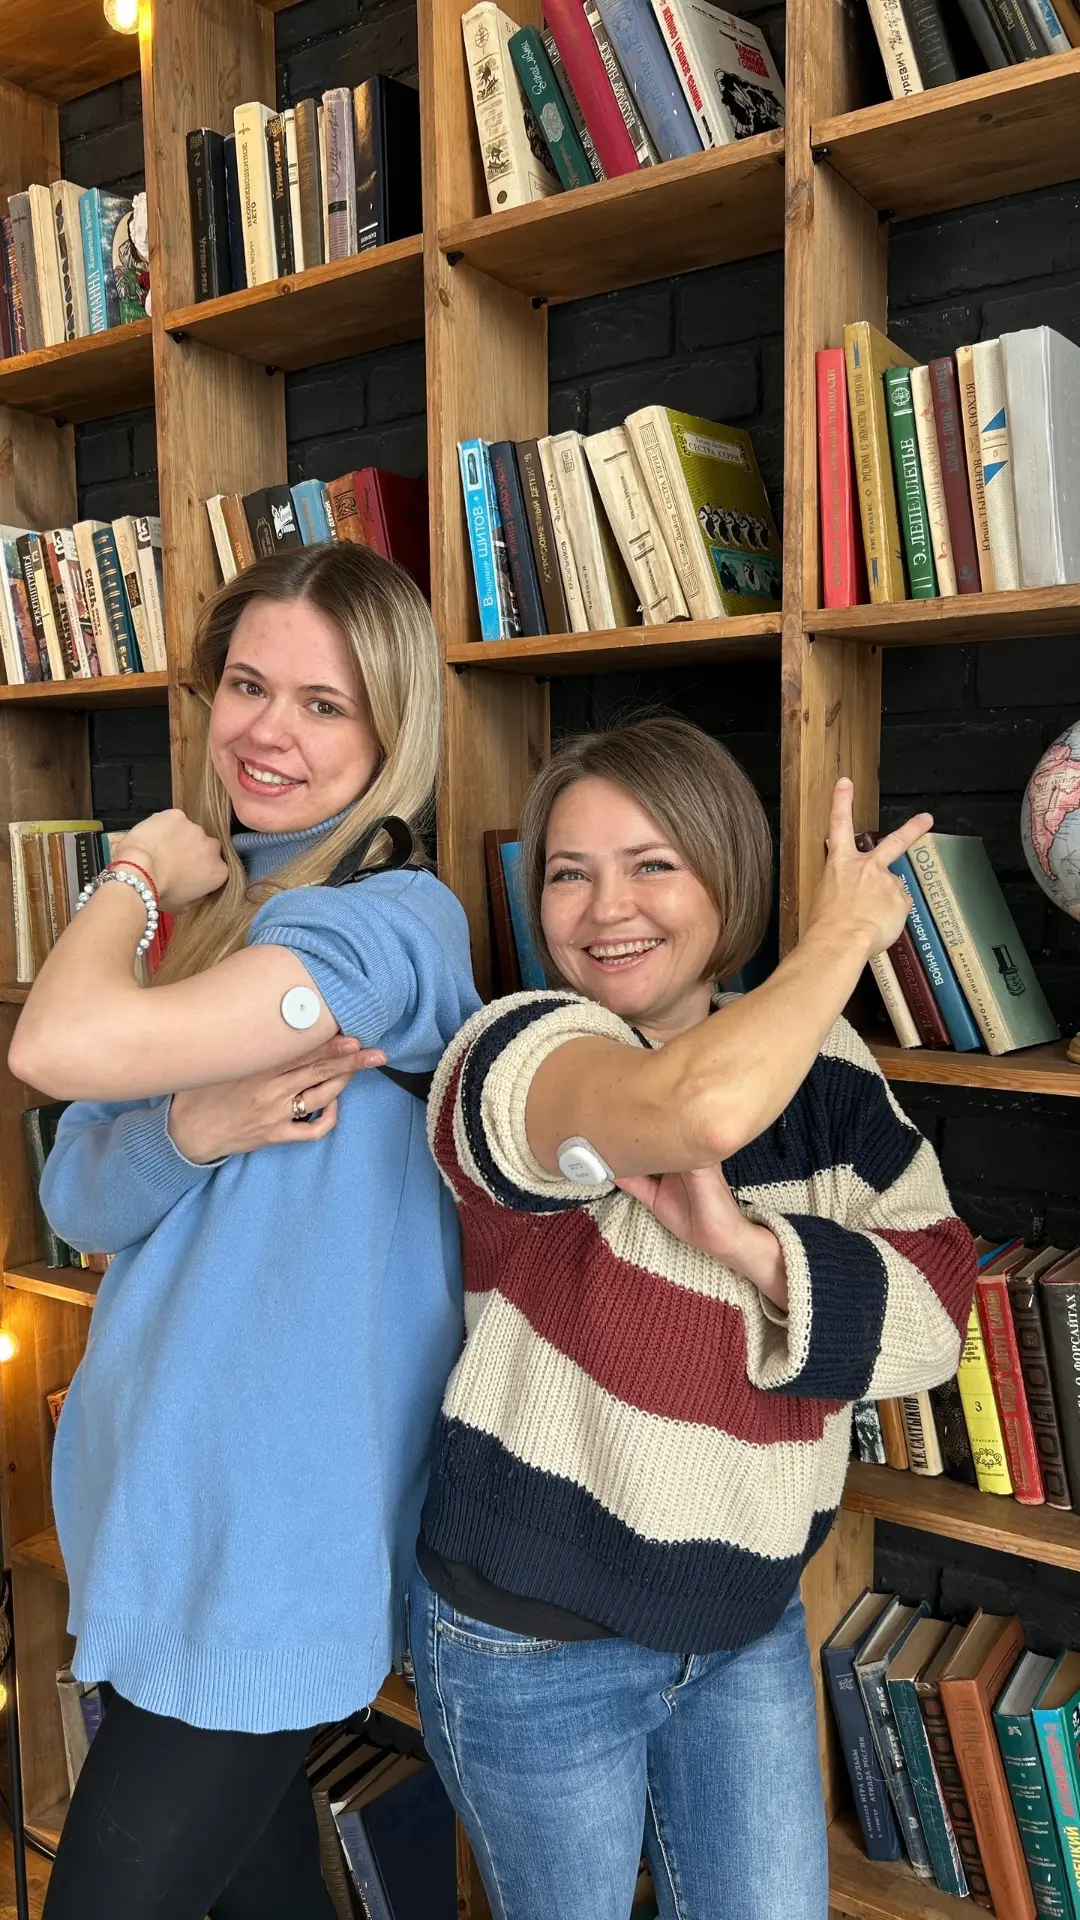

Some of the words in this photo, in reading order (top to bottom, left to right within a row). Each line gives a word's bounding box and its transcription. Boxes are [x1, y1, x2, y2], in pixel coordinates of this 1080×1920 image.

[17, 240, 30, 282] ИСТОКИ
[856, 372, 866, 406] ВЕРНОМ
[940, 363, 952, 405] БОРХЕС
[965, 383, 979, 427] КЮХЛЯ
[651, 453, 664, 479] КЕРРИ
[689, 443, 716, 457] СЕСТРА
[717, 448, 740, 462] КЕРРИ
[862, 455, 871, 482] РЯДОМ
[946, 438, 959, 471] ХОРХЕ
[524, 453, 539, 498] ДЕТЕКТВ
[660, 480, 674, 509] СЕСТРА
[902, 438, 927, 546] ЛЕПЕЛЛЕТЬЕ
[974, 457, 986, 517] ТЫНЯНОВ
[325, 501, 335, 527] ДЕМОН
[474, 506, 490, 559] ШИТОВ
[534, 499, 552, 583] СТРОСЮЖЕНЫЙ
[679, 542, 690, 567] Теодор
[912, 547, 926, 566] Э.
[561, 541, 574, 590] КРАСИЛЬНИКОВ
[84, 567, 98, 607] ЧЕЙЗ
[913, 845, 935, 883] 1036
[899, 874, 928, 941] АФГАНИЕ
[926, 882, 957, 948] КЕННЕДИ
[944, 896, 964, 945] президента
[922, 943, 931, 951] В
[899, 954, 924, 1009] БЕСТУЖЕВ
[925, 951, 944, 985] ВОЙНА
[976, 998, 996, 1039] ГРОМЫКО
[1066, 1294, 1080, 1372] ФОРСАЙТАХ
[975, 1401, 983, 1412] 3
[851, 1749, 862, 1781] СУДЬБЫ
[859, 1737, 870, 1771] РОССИИ
[855, 1781, 866, 1802] ИГРА
[865, 1772, 876, 1802] АТИЛЛА
[1064, 1826, 1080, 1888] РЕЦКИЙ
